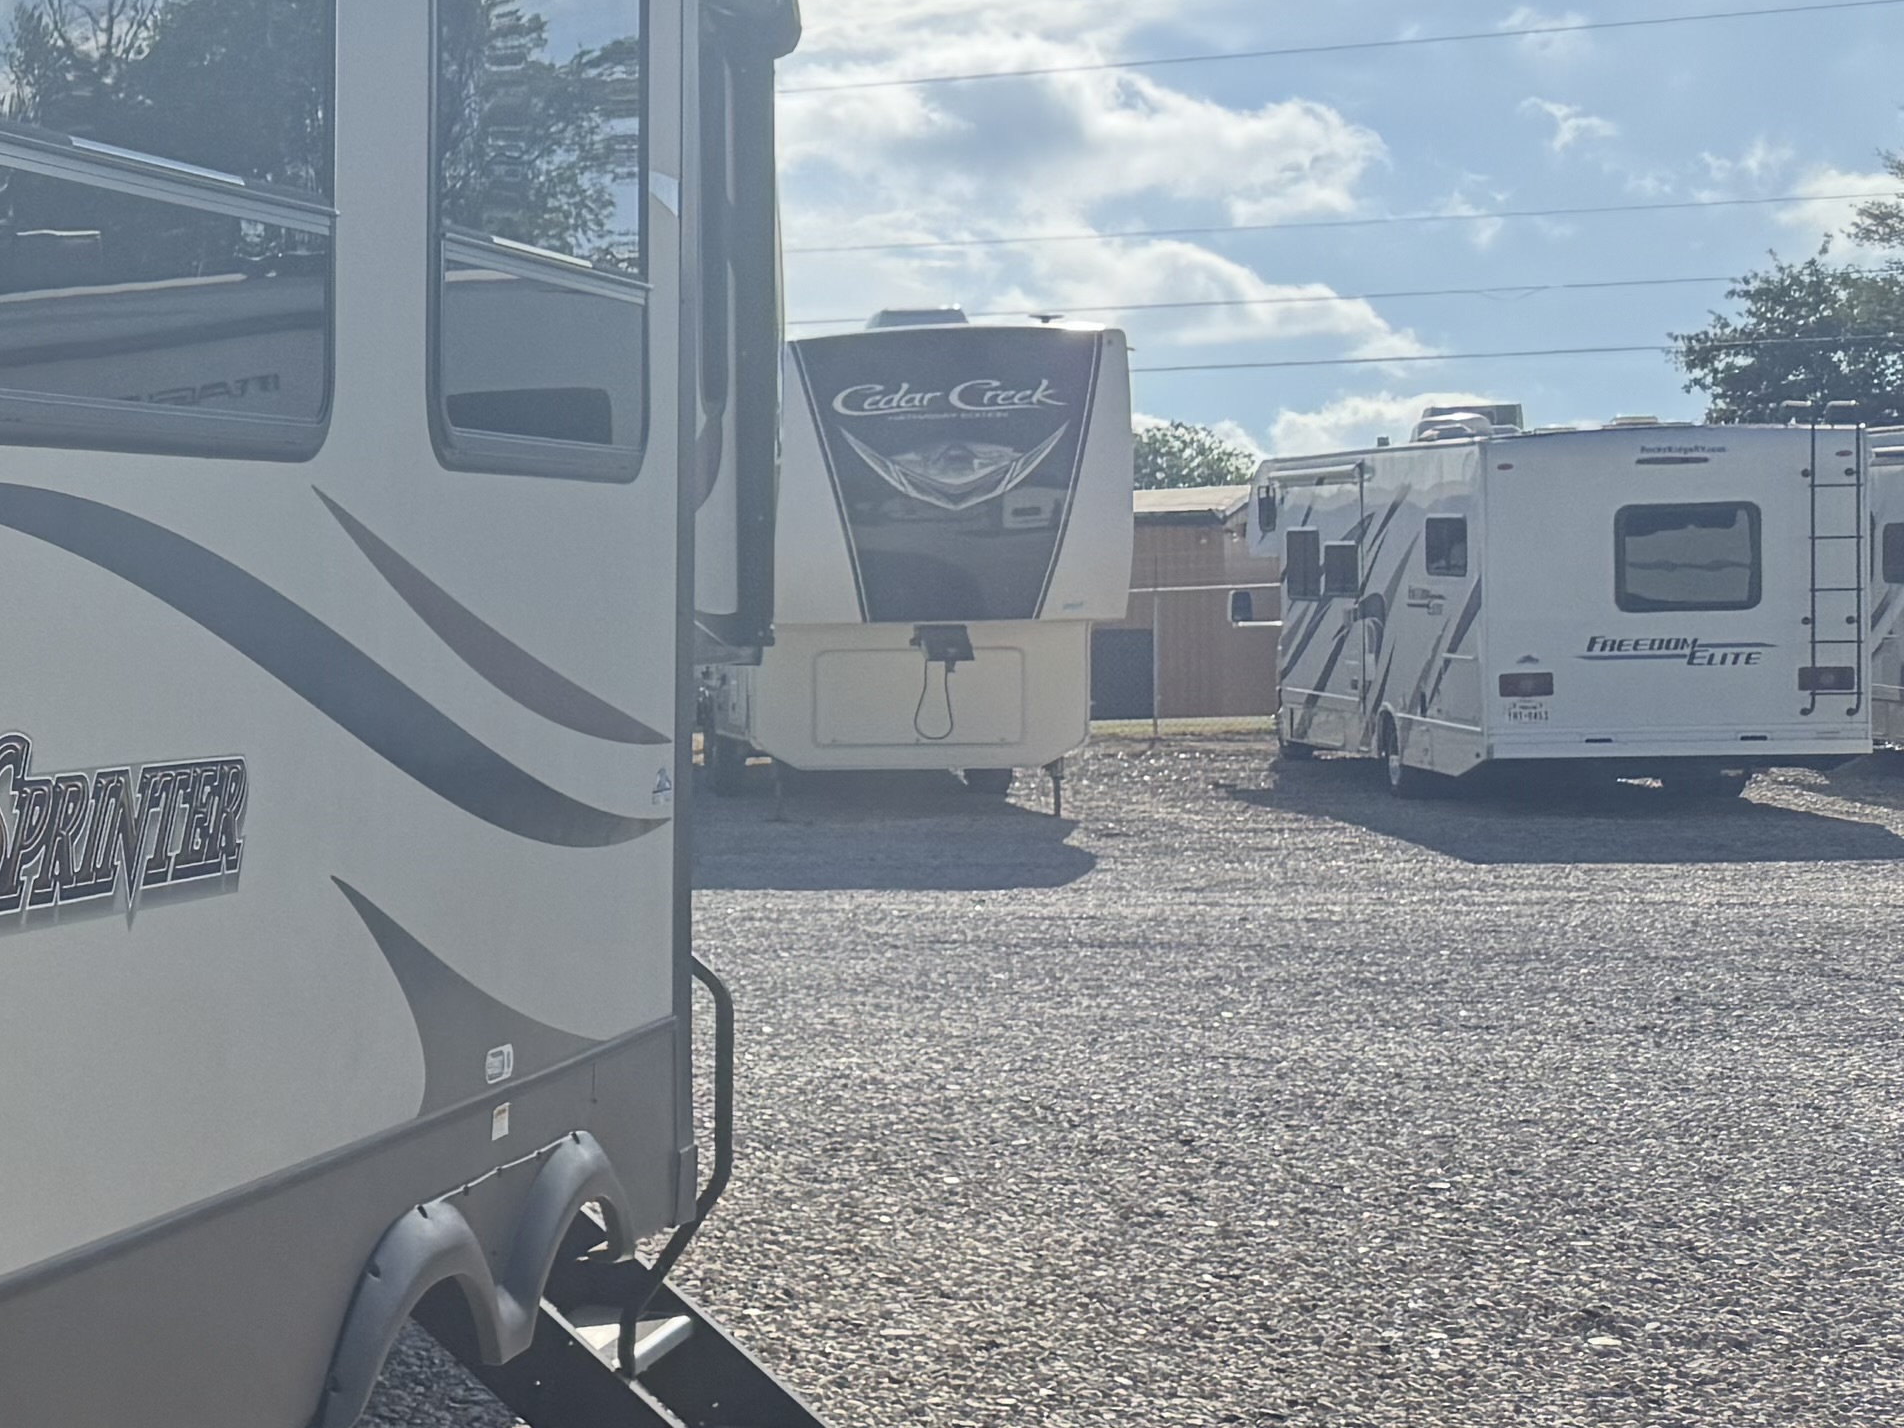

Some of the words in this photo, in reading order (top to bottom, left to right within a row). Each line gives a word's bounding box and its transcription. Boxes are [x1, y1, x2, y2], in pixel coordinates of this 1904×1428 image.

[832, 381, 941, 416] Cedar
[949, 378, 1069, 410] Creek
[1586, 635, 1699, 652] FREEDOM
[1686, 649, 1762, 667] ELITE
